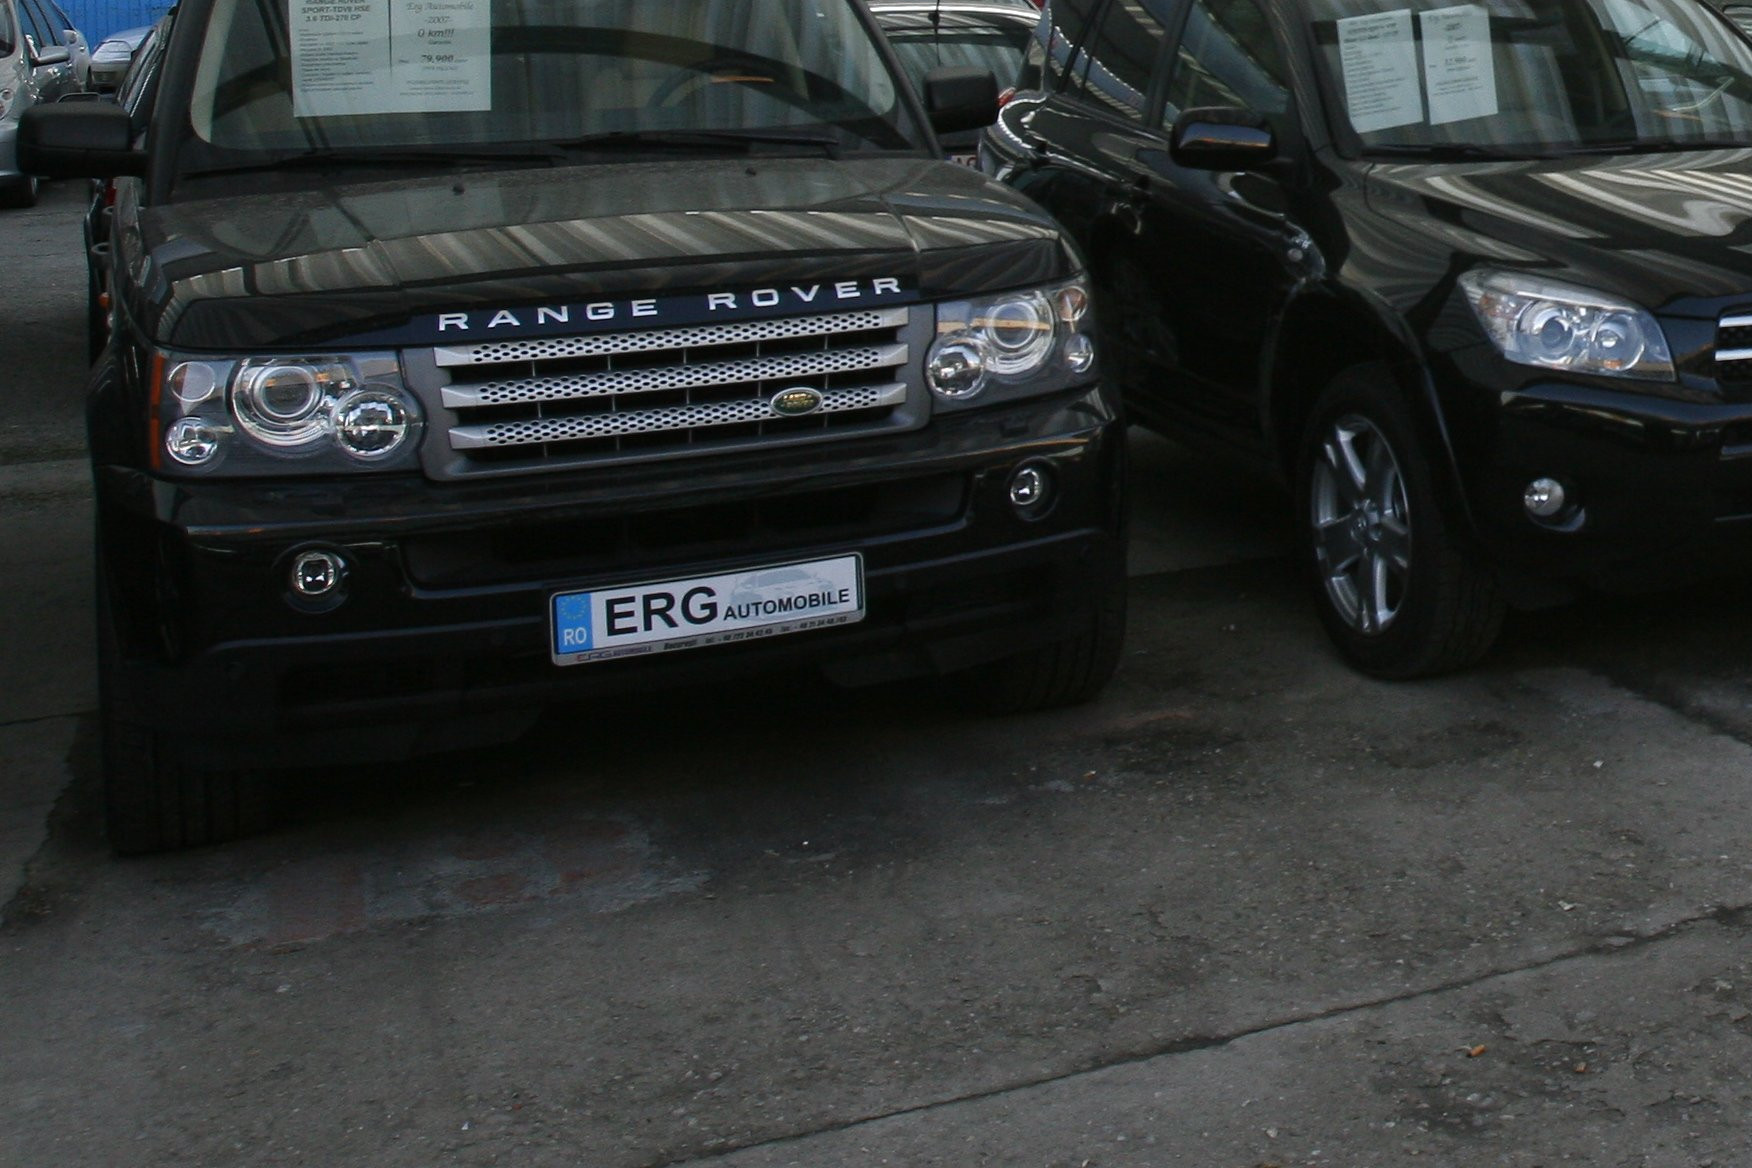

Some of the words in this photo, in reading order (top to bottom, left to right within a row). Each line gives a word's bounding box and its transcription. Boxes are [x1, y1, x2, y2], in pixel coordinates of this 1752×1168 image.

[438, 299, 658, 332] RANGE
[708, 277, 901, 312] ROVER
[563, 626, 588, 647] RO
[605, 585, 718, 637] ERG
[723, 587, 851, 622] AUTOMOBILE
